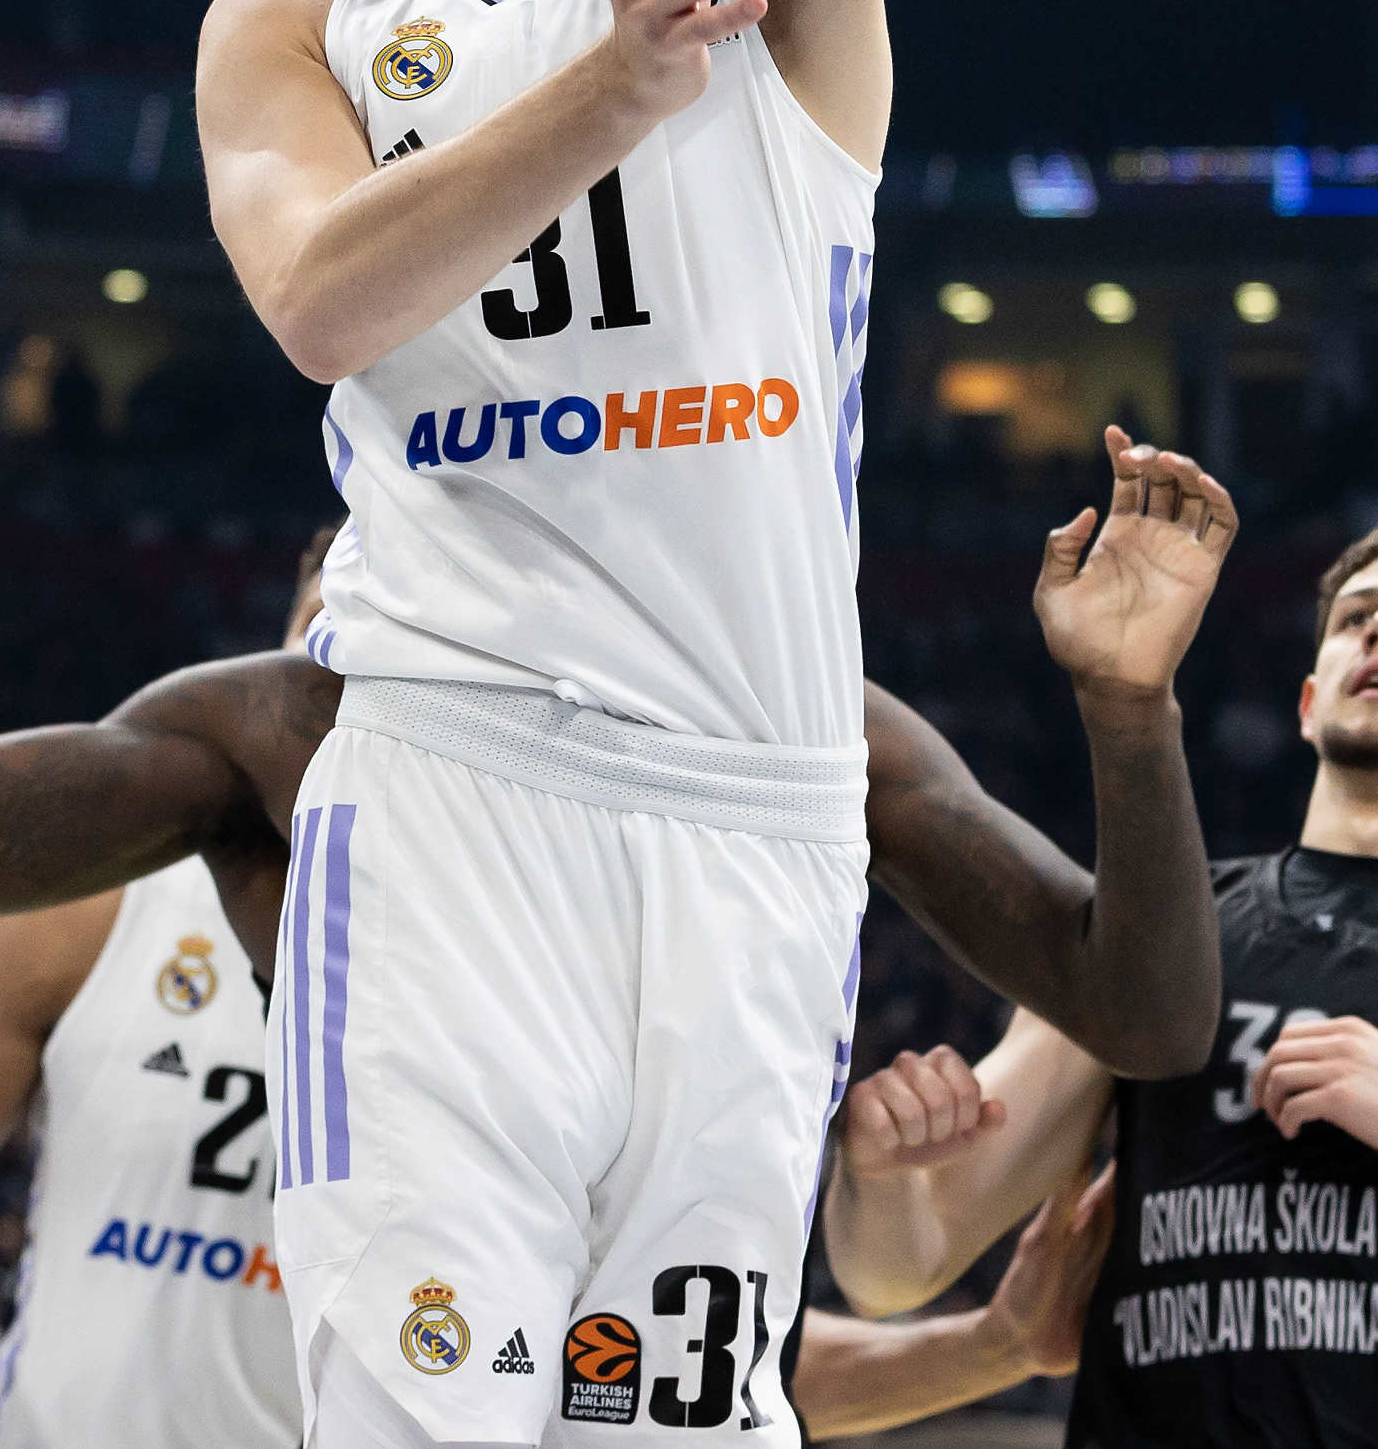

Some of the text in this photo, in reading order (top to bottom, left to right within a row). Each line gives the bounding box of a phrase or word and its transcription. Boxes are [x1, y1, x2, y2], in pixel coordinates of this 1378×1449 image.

[481, 166, 651, 341] 31
[406, 378, 799, 470] AUTOHERO
[1213, 1002, 1329, 1123] 3
[189, 1065, 276, 1198] 2
[87, 1216, 284, 1295] AUTOH
[1273, 1167, 1377, 1257] ŠKOLA
[492, 1355, 534, 1374] adidas
[570, 1383, 634, 1398] TURKISH
[648, 1265, 775, 1431] 31
[568, 1405, 630, 1421] EuroLeague
[570, 1395, 632, 1410] AIRLINES
